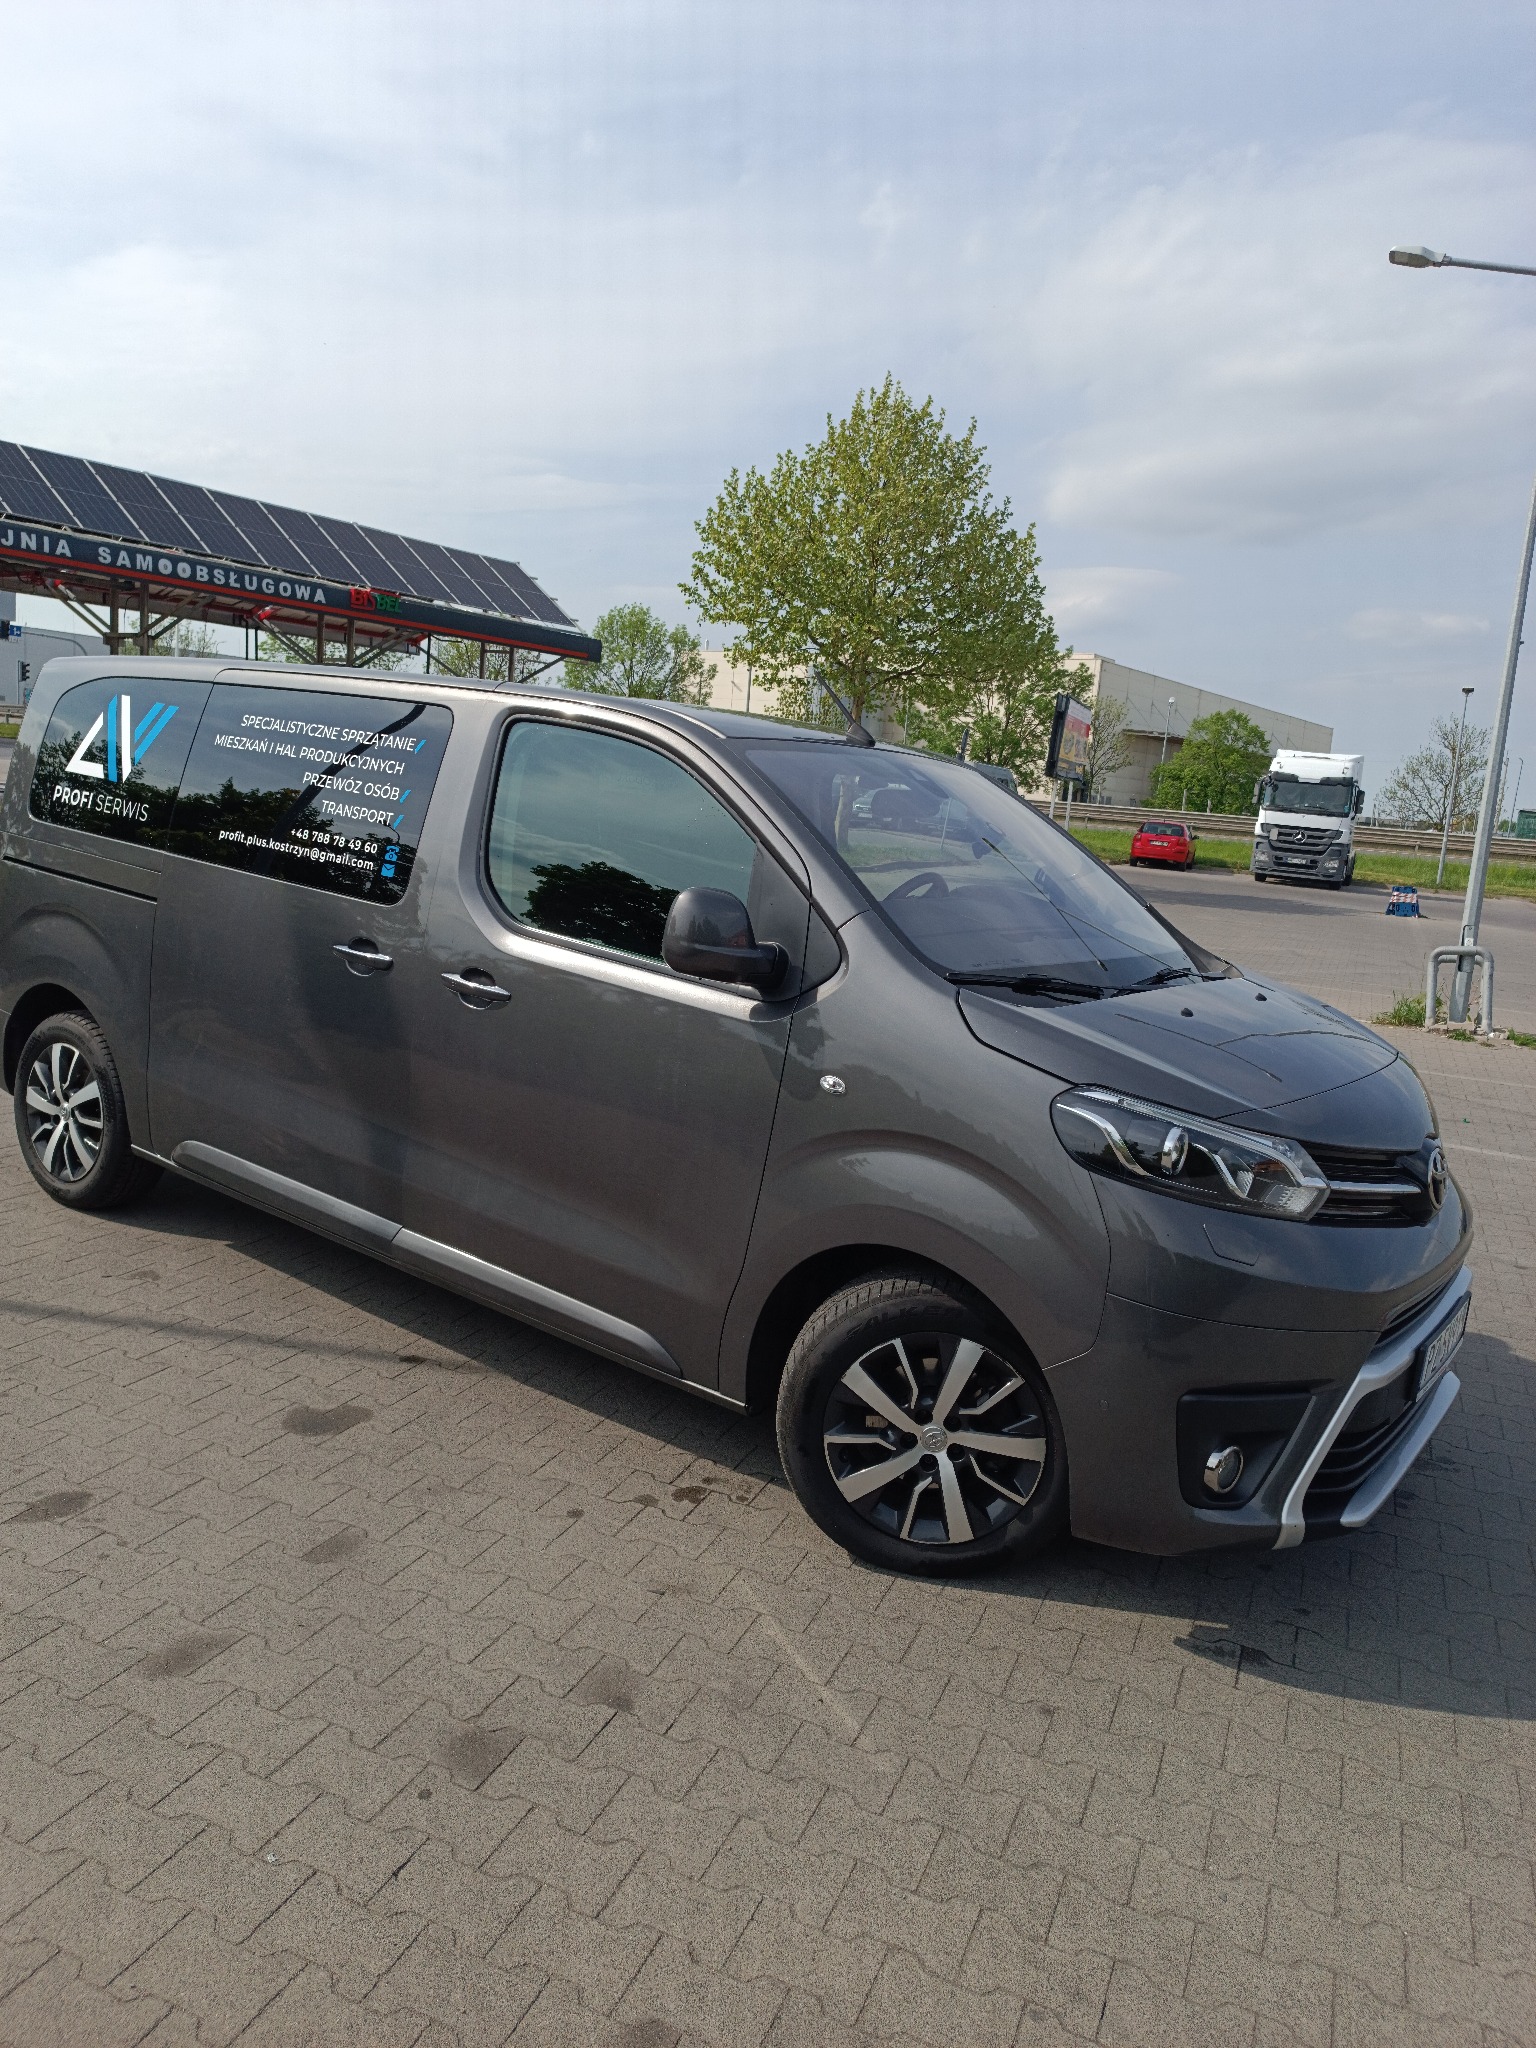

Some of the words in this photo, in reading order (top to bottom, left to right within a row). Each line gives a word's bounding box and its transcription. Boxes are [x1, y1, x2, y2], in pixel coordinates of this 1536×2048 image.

[1, 529, 72, 558] JNIA
[98, 546, 327, 604] SAMOOBSŁUGOWA
[240, 714, 340, 740] SPECJALISTYCZNE
[340, 729, 417, 751] SPRZĄTANIE
[214, 734, 269, 753] MIESZKAŃ
[269, 743, 274, 754] I
[275, 745, 297, 758] HAL
[299, 747, 405, 775] PRODUKCYJNYCH
[53, 785, 94, 809] PROFI
[95, 794, 150, 822] SERWIS
[302, 772, 362, 794] PRZEWÓZ
[364, 779, 400, 801] OSÓB
[321, 800, 394, 826] TRANSPORT
[218, 829, 374, 870] profit.plus.kostrzyn@gmail.com
[291, 828, 309, 840] +48
[312, 831, 330, 844] 788
[333, 835, 346, 848] 78
[348, 839, 362, 851] 49
[364, 842, 378, 854] 60
